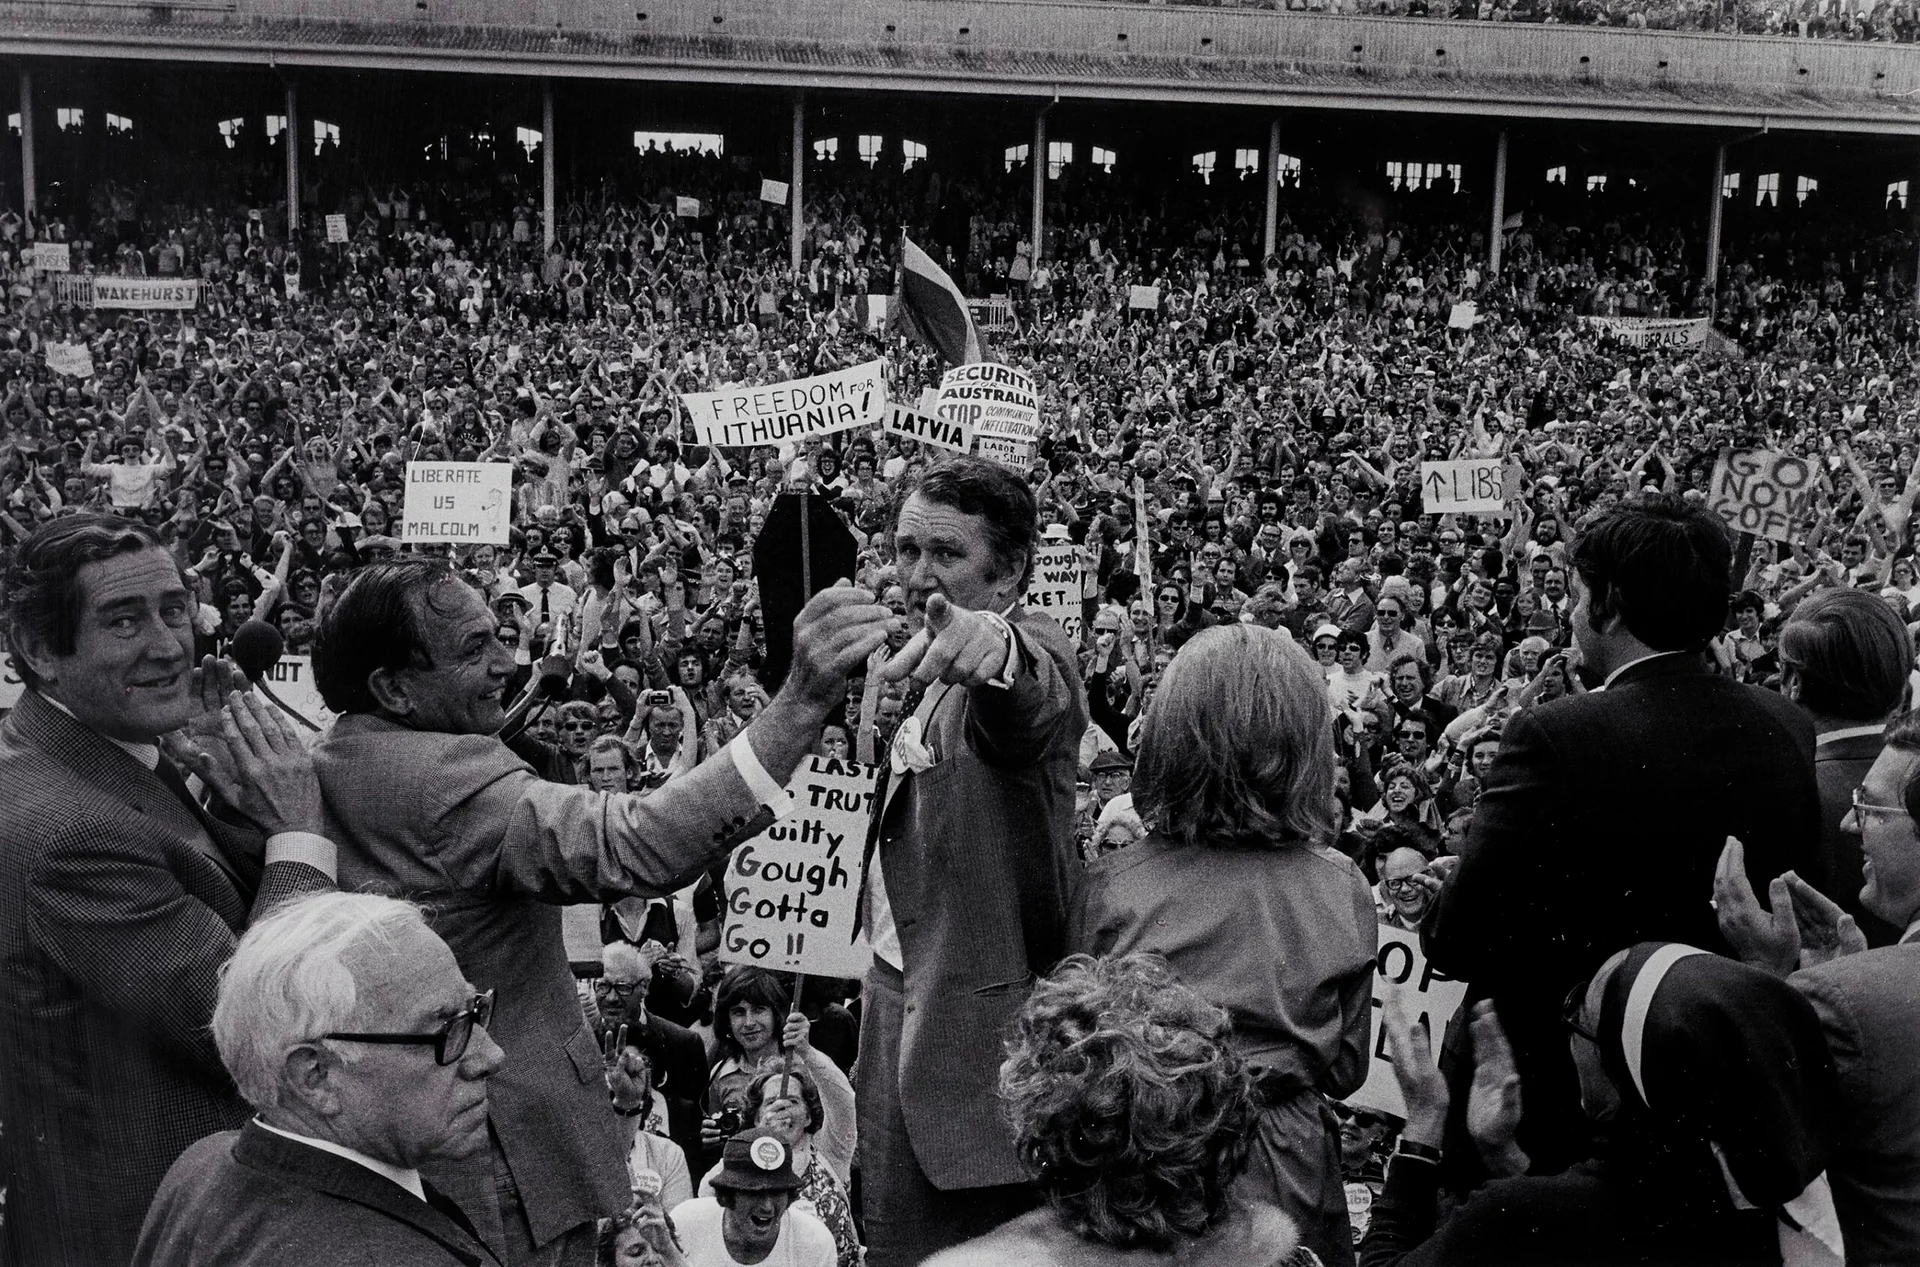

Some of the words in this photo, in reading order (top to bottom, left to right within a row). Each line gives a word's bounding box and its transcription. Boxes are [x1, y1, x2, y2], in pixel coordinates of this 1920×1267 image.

[97, 286, 196, 301] WAKEHURST
[946, 366, 1034, 392] SECURITY
[712, 380, 845, 420] FREEDOM
[850, 378, 874, 395] FOR
[941, 387, 1037, 410] AUSTRALIA
[892, 409, 964, 448] LATVIA
[984, 442, 1015, 453] LABOR
[411, 469, 482, 484] LIBERATE
[1727, 449, 1809, 488] GO
[1453, 466, 1501, 502] LIBS
[434, 496, 455, 509] US
[407, 522, 479, 537] MALCOLM
[1044, 570, 1078, 584] WAY
[1021, 590, 1081, 606] KET....
[809, 757, 879, 779] LAST
[735, 846, 848, 896] Gough
[729, 886, 830, 928] Gotta
[725, 923, 771, 959] Go
